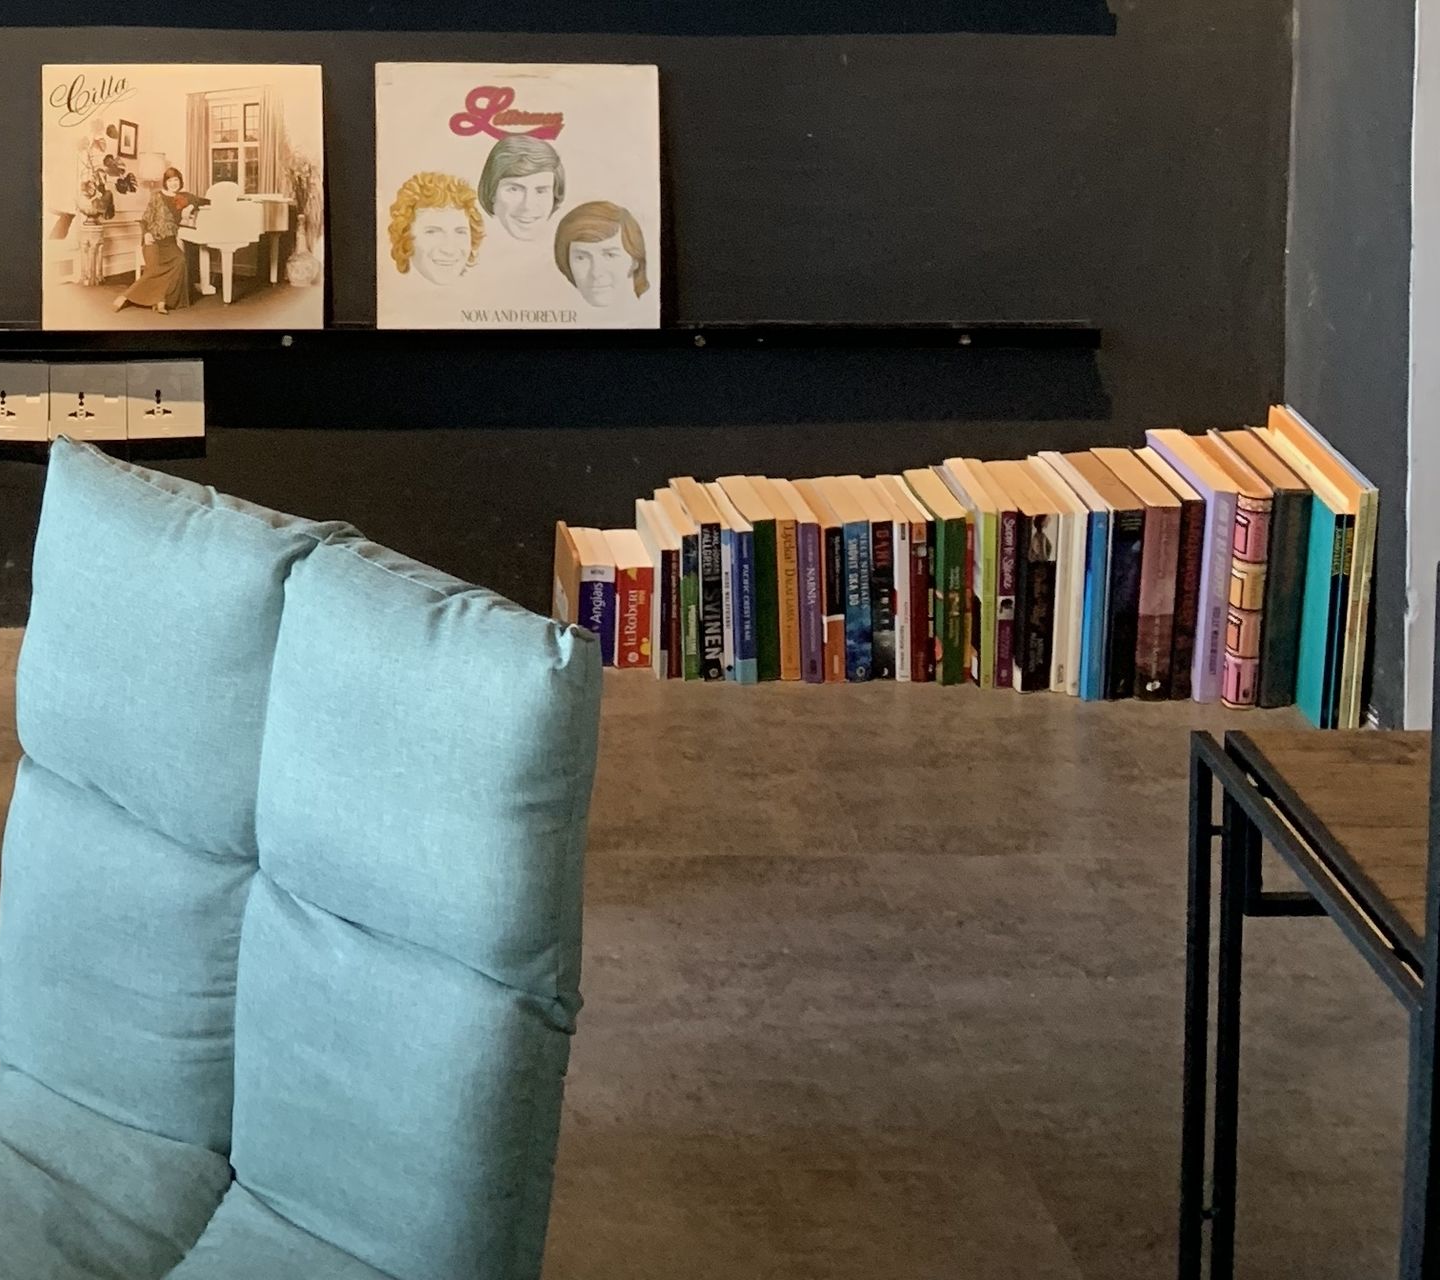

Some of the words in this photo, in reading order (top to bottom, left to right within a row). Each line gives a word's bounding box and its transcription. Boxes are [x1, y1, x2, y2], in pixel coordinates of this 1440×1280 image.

[49, 74, 138, 128] Cilla
[461, 310, 491, 322] NOW
[492, 310, 518, 322] AND
[520, 310, 577, 322] FOREVER
[590, 582, 606, 623] Anglais
[806, 567, 816, 604] NARNIA
[704, 587, 722, 659] SVINEN
